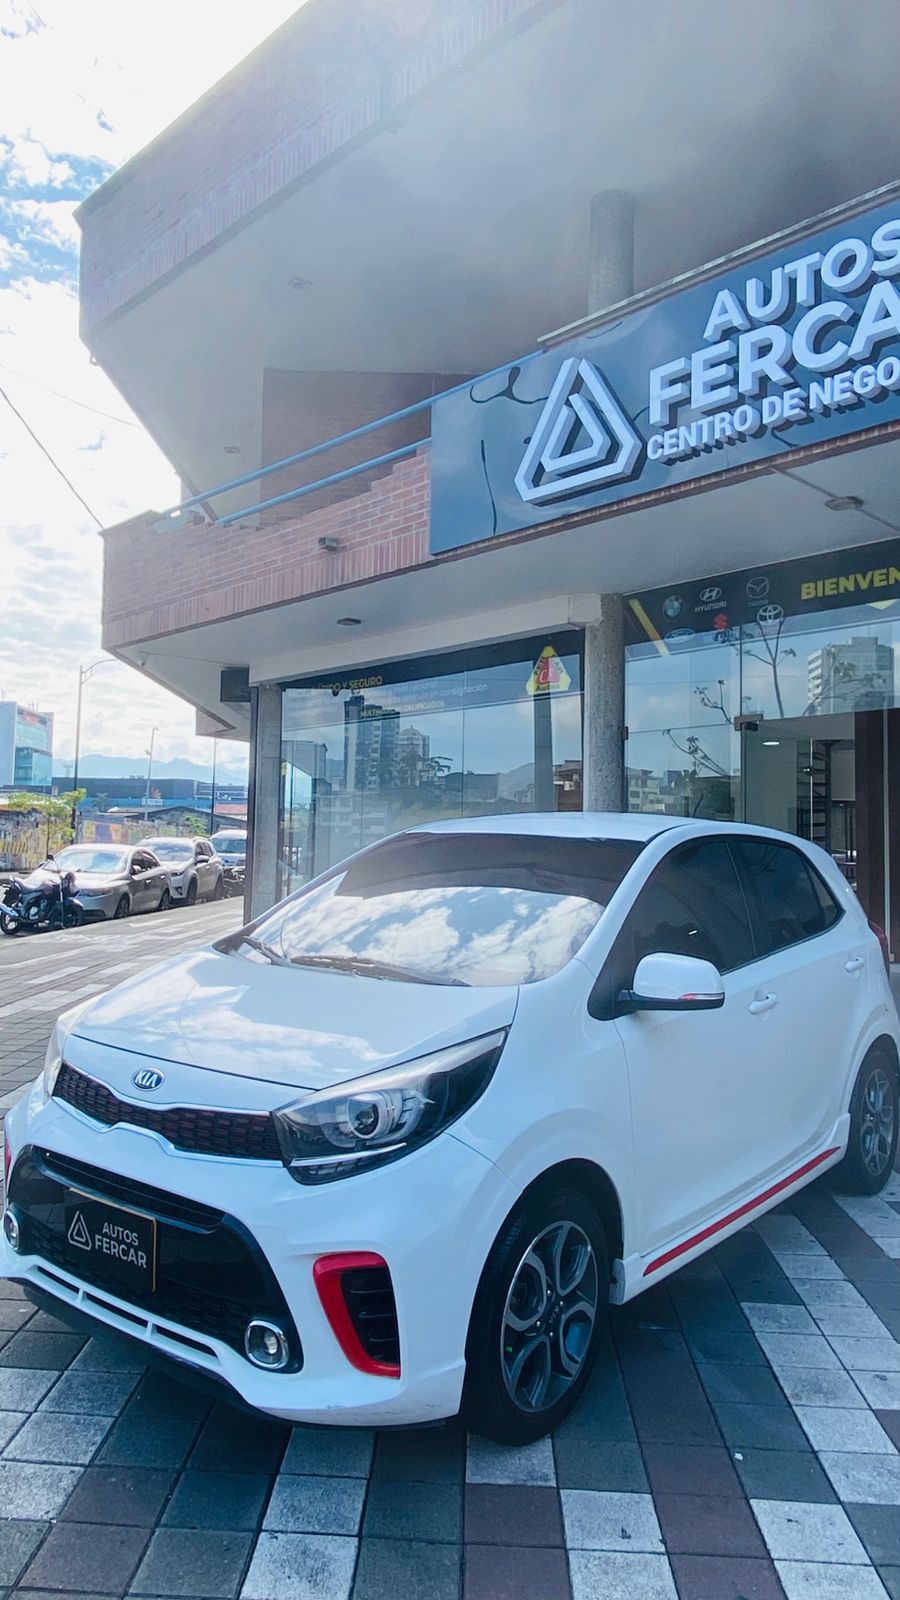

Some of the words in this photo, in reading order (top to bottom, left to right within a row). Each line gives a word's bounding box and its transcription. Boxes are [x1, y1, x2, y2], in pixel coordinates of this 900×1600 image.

[703, 218, 900, 341] AUTOS
[649, 280, 900, 426] FERCA
[647, 404, 761, 461] CENTRO
[762, 387, 807, 425] DE
[809, 355, 900, 411] NEGO
[695, 601, 727, 613] HYUNDAI
[350, 676, 383, 689] SEGURO
[134, 1070, 158, 1088] KIA
[102, 1221, 139, 1246] AUTOS
[95, 1234, 147, 1269] FERCAR
